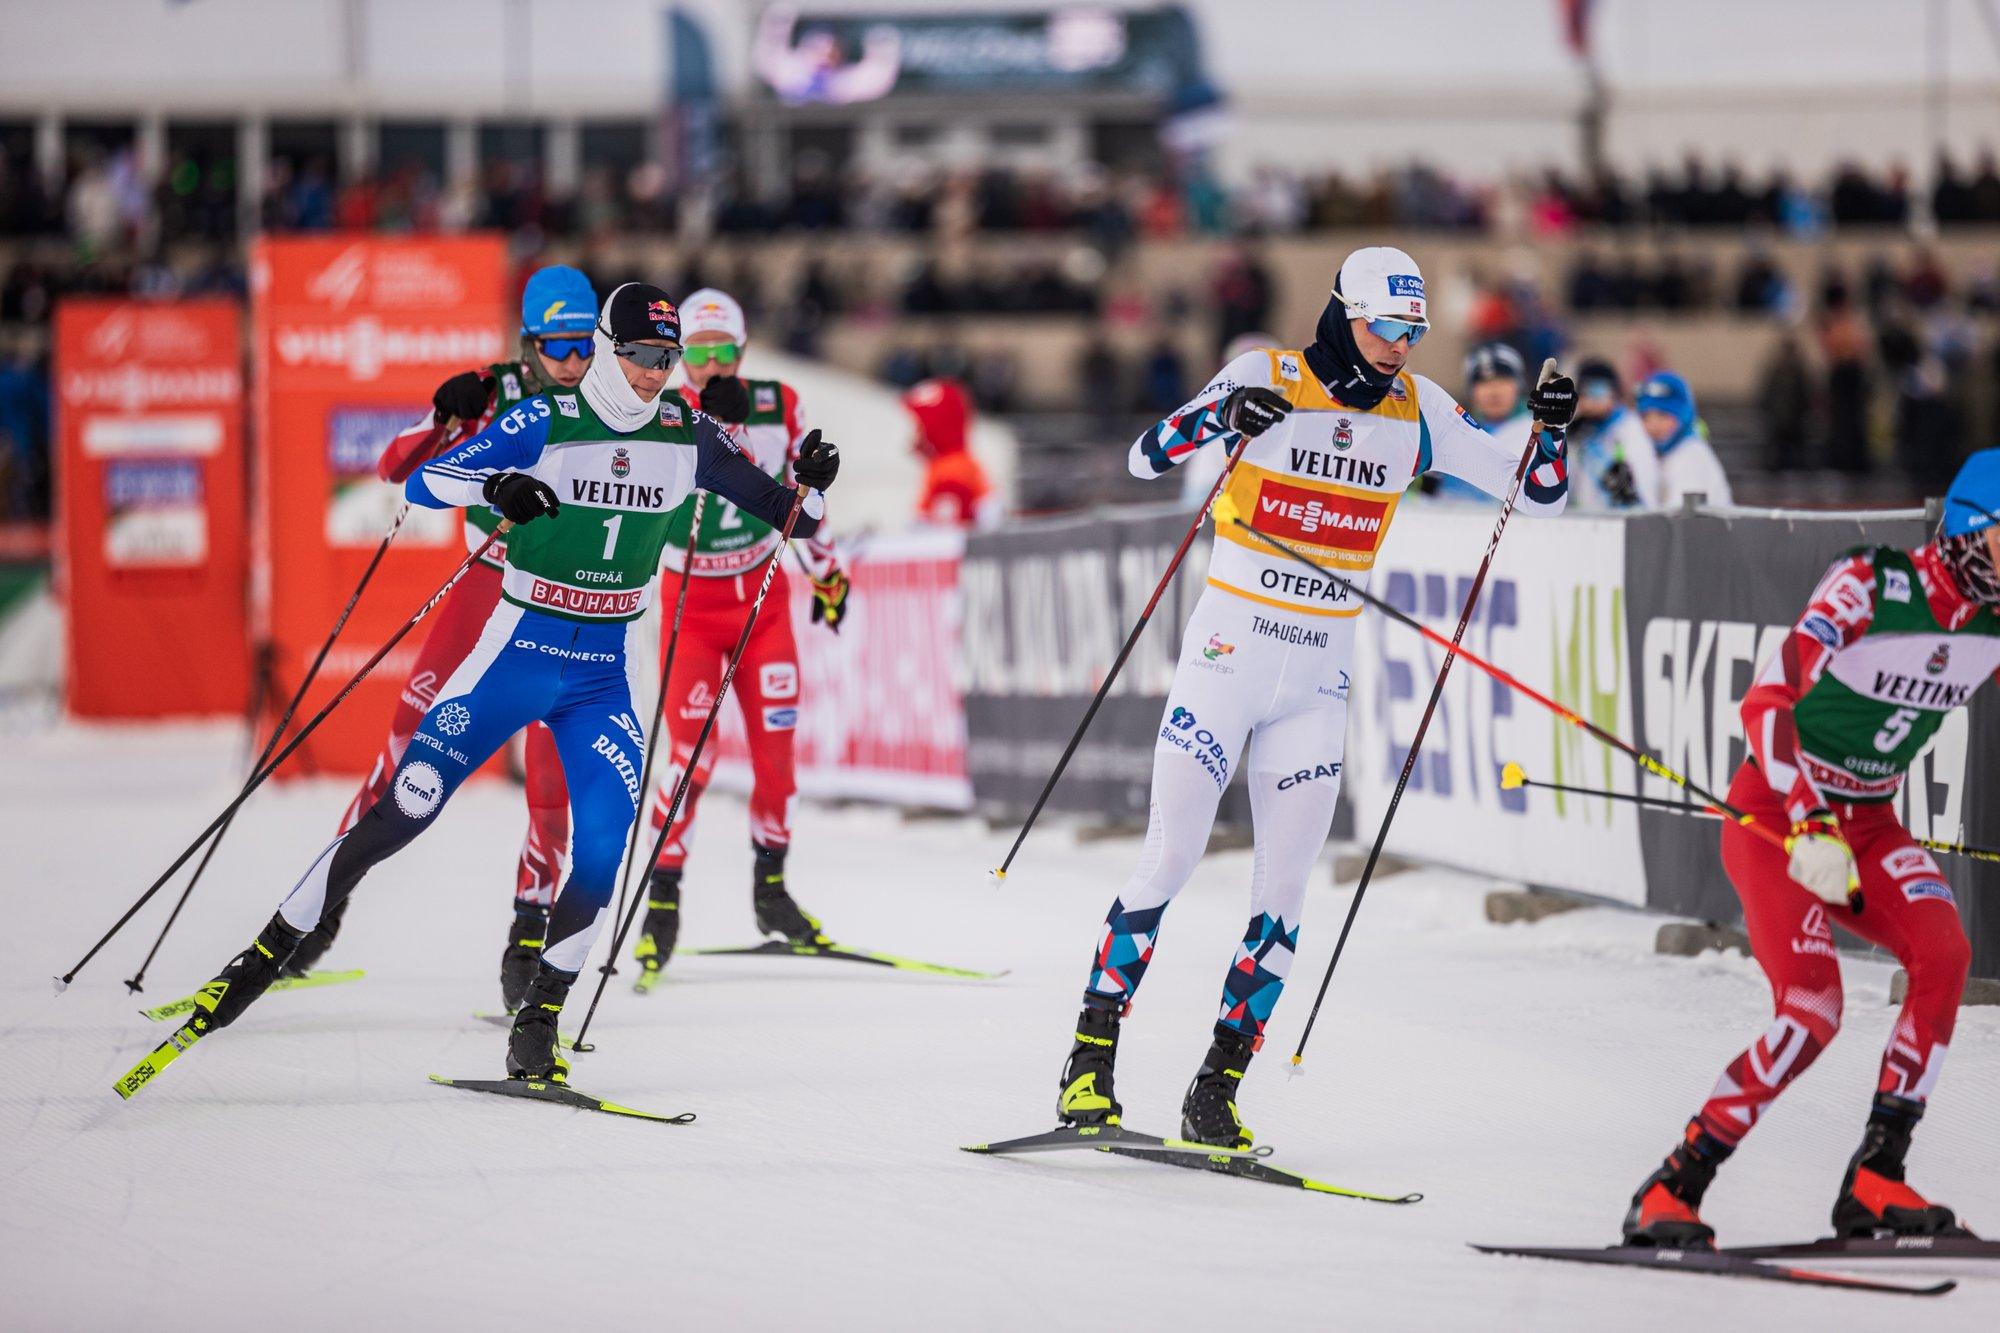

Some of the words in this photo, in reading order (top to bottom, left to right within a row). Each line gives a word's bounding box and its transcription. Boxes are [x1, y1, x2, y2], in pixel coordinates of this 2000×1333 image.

[500, 399, 551, 434] CF&S
[717, 430, 739, 455] invest
[1290, 447, 1388, 488] VELTINS
[572, 479, 664, 509] VELTINS
[1261, 496, 1381, 533] VIESSMANN
[602, 514, 623, 560] 1
[1294, 543, 1338, 559] COMBINED
[1338, 551, 1362, 563] WORLD
[575, 569, 623, 584] OTEPÄÄ
[1260, 567, 1351, 602] OTEPÄÄ
[531, 580, 642, 614] BAUHAUS
[1253, 616, 1328, 648] THAUGLAND
[540, 645, 616, 662] CONNECTO
[1873, 670, 1969, 706] VELTINS
[1161, 726, 1193, 752] Block
[1873, 708, 1921, 753] 5
[401, 775, 437, 802] Farmi
[1277, 762, 1343, 791] CRAF
